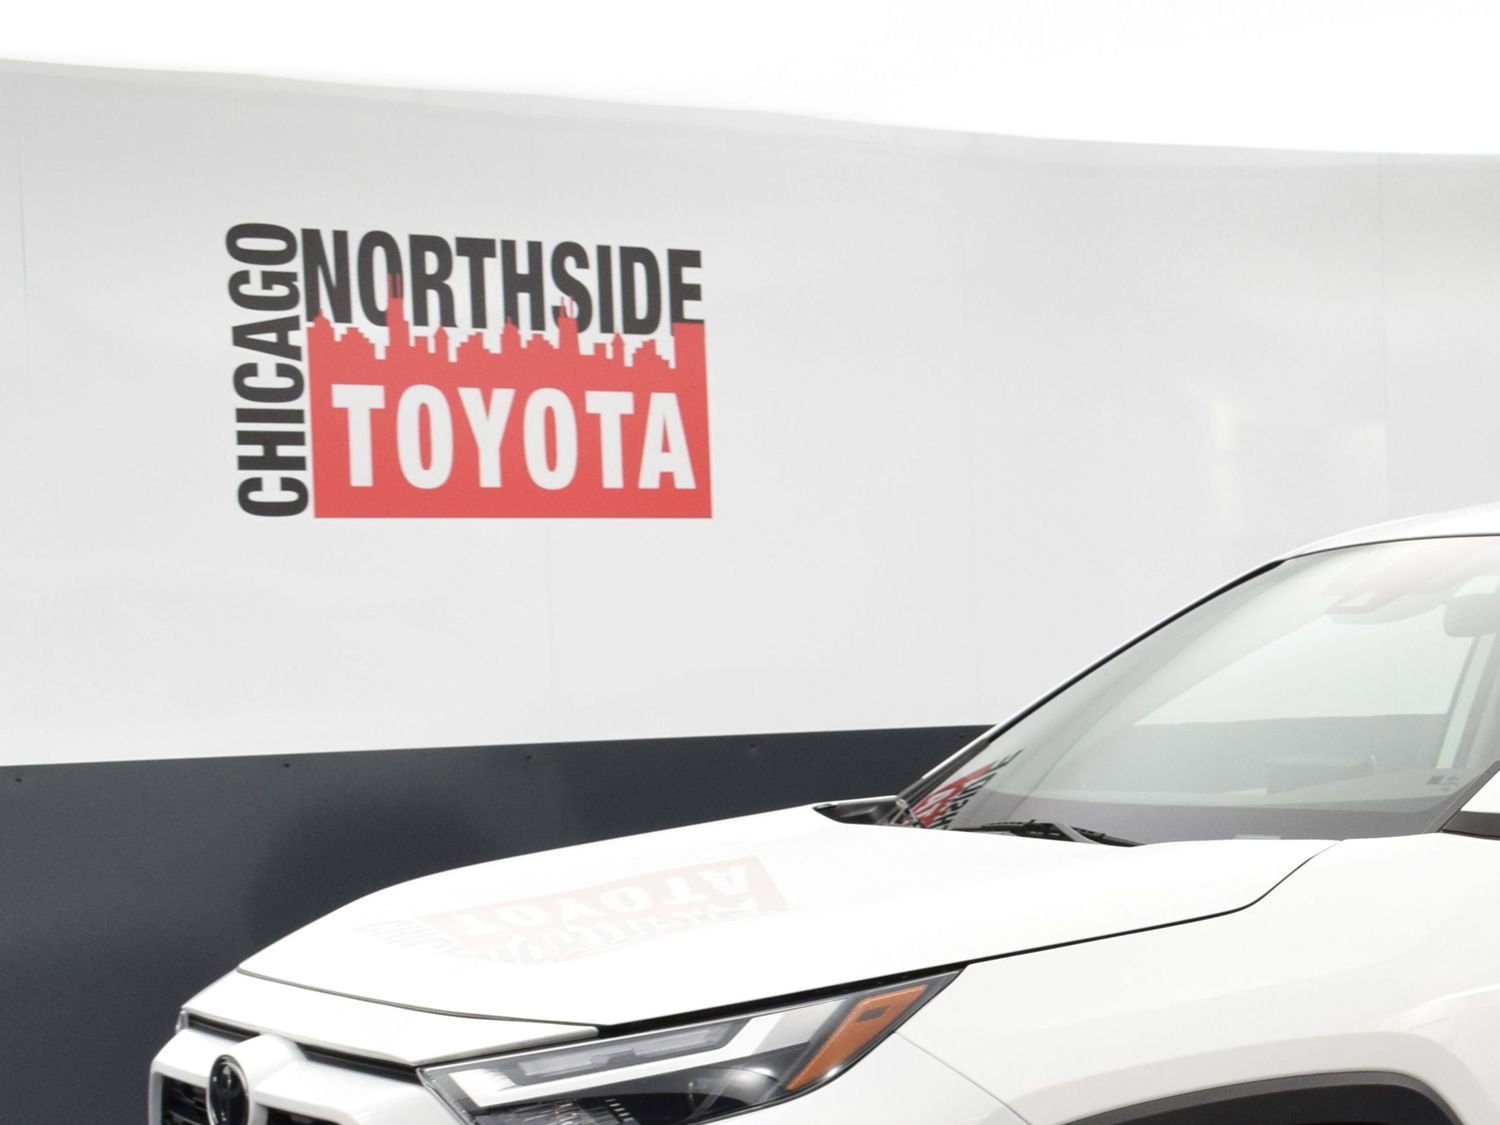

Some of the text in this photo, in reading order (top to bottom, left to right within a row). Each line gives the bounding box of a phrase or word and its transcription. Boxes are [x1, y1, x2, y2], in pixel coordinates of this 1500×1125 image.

[301, 228, 703, 337] NORTHSIDE
[225, 222, 309, 517] CHICAGO
[331, 383, 697, 490] TOYOTA
